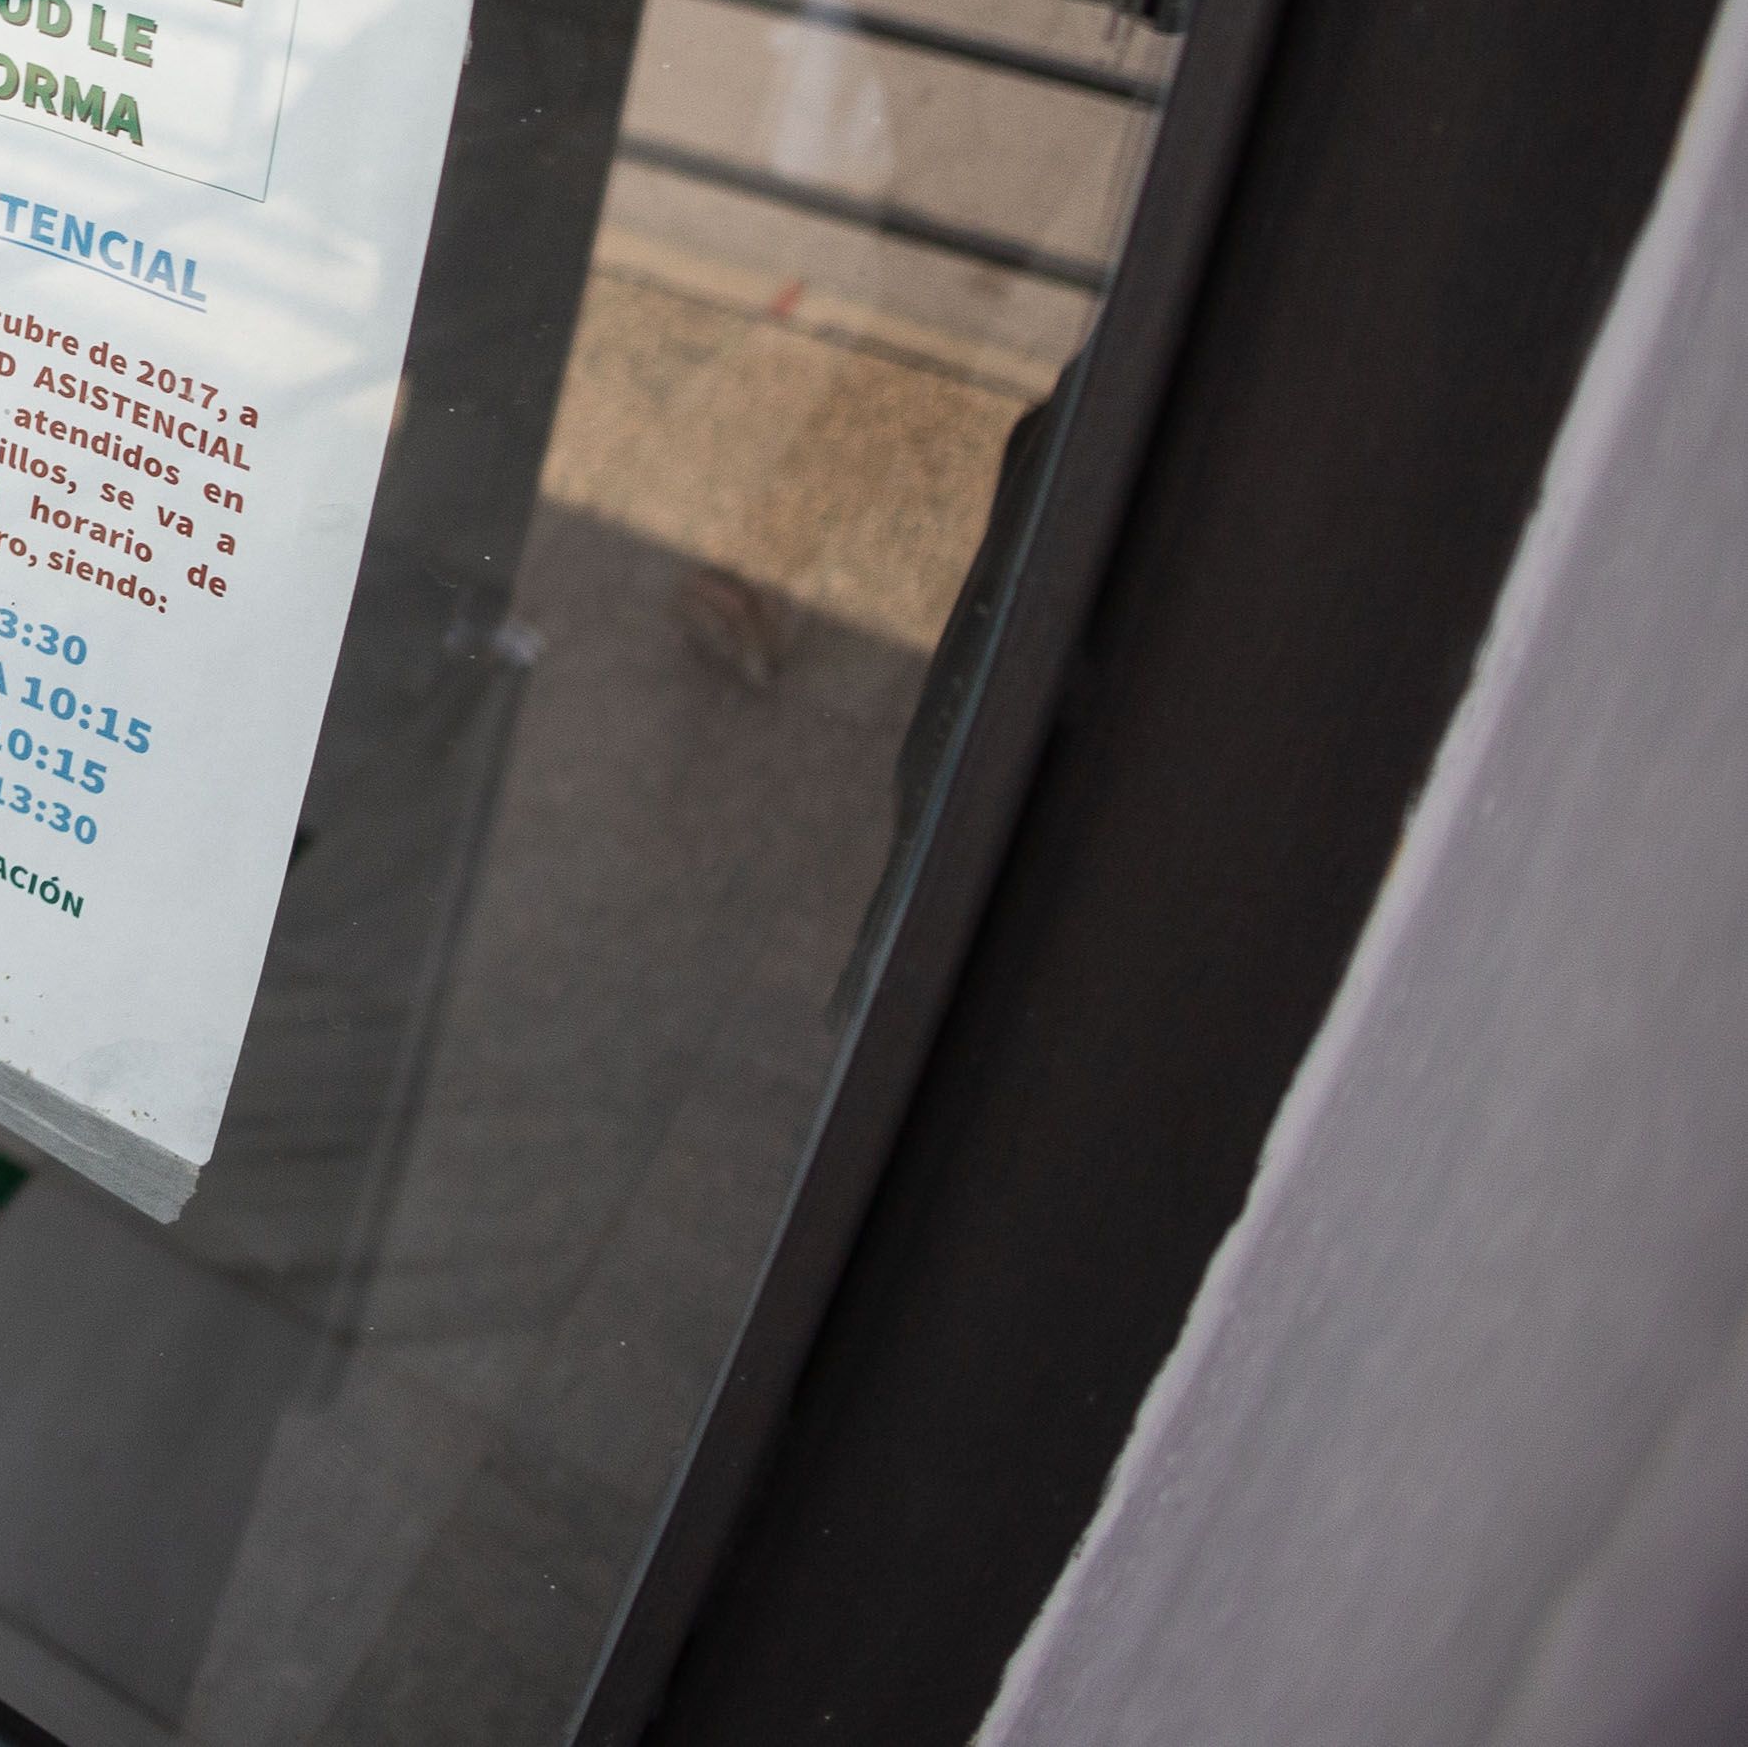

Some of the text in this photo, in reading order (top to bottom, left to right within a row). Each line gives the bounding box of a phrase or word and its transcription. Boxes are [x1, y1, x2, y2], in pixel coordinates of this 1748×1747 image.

[88, 3, 158, 68] LE
[33, 365, 251, 472] ASISTENCIAL
[88, 341, 127, 375] de
[136, 360, 227, 423] 2017,
[239, 405, 259, 429] a
[13, 407, 180, 486] atendidos
[203, 482, 244, 514] en
[30, 495, 153, 564] horario
[187, 563, 227, 598] de
[100, 482, 135, 511] se
[156, 505, 194, 538] va
[216, 532, 236, 556] a
[47, 549, 167, 614] siendo:
[20, 676, 152, 754] 10:15
